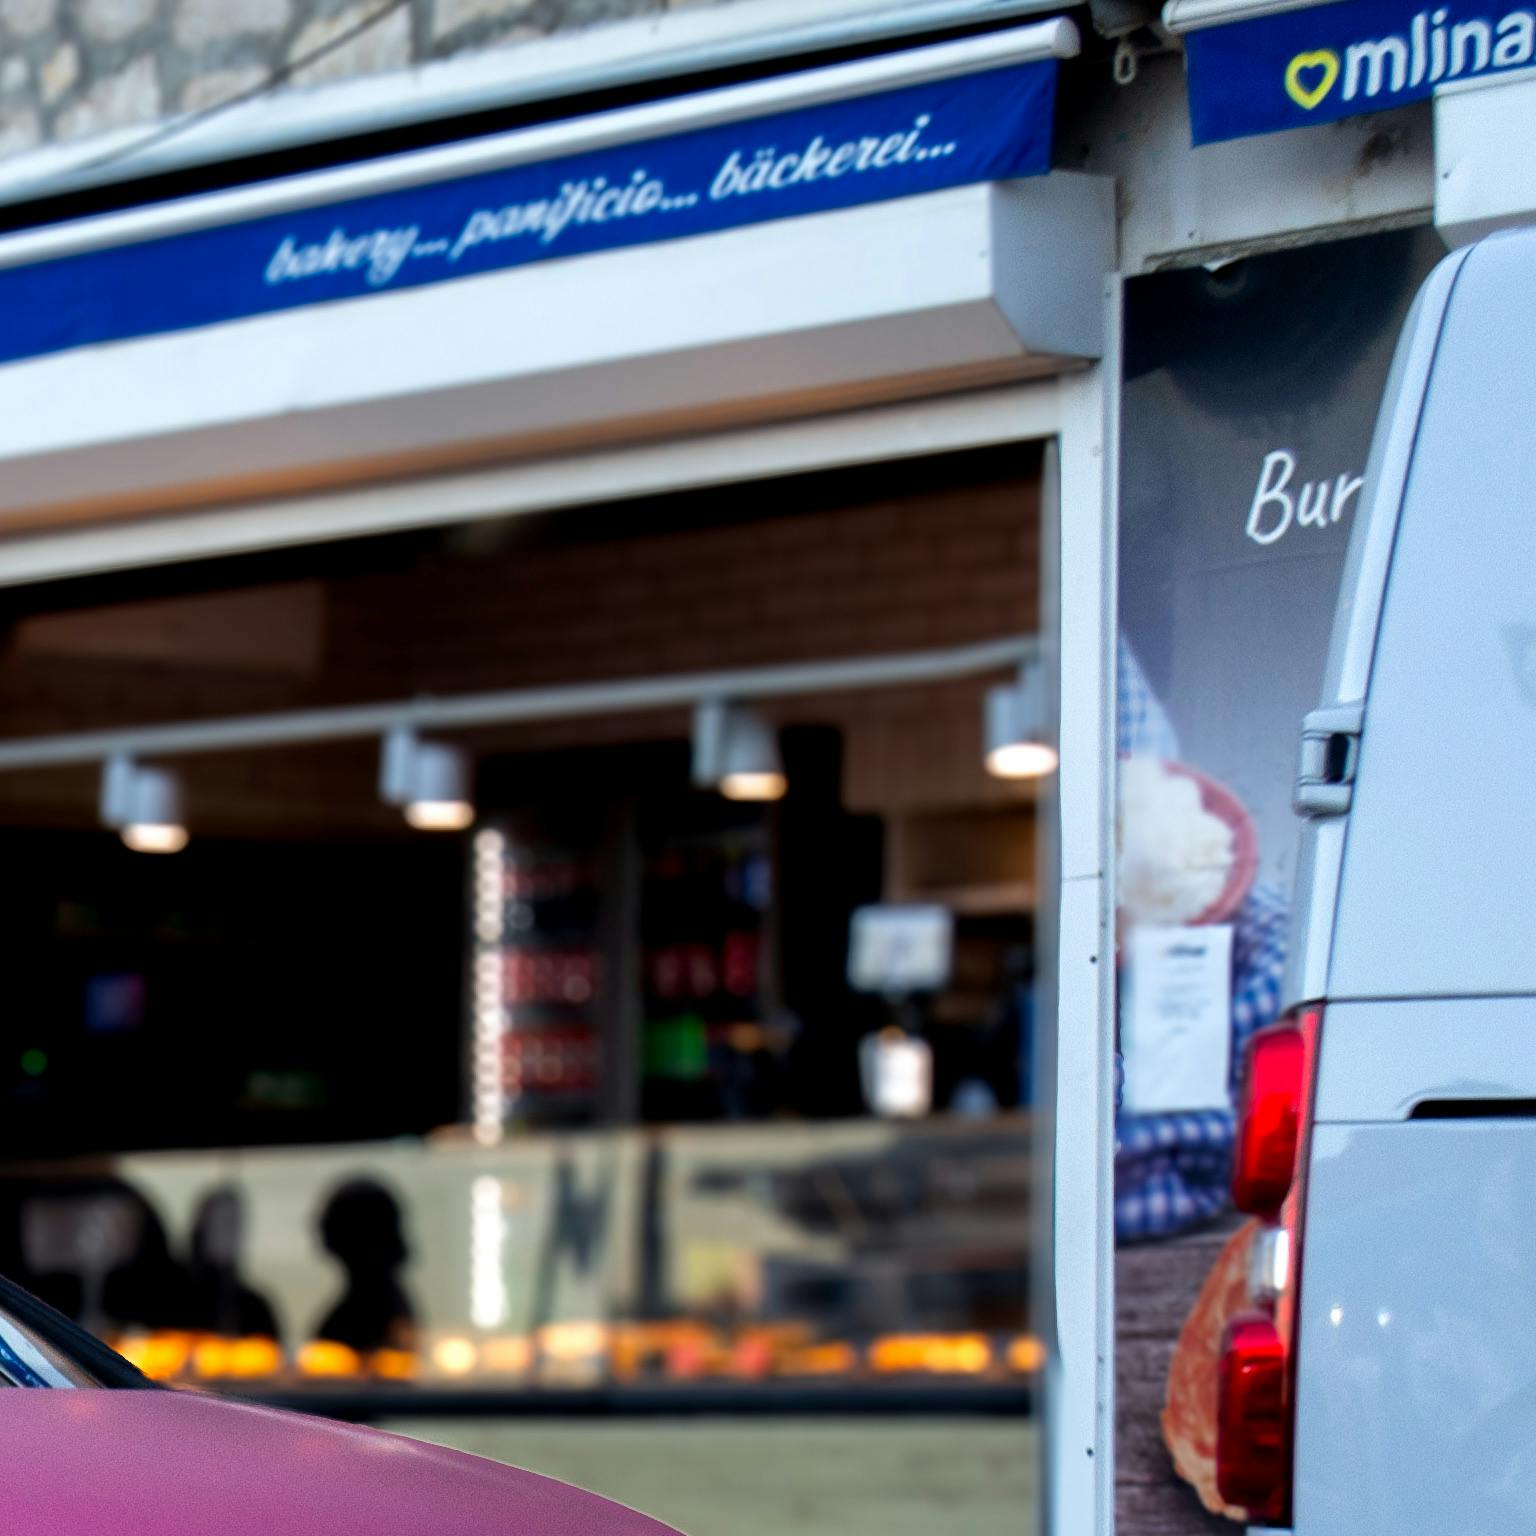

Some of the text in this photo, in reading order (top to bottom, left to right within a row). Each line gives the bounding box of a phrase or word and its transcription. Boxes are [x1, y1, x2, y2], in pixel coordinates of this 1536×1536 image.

[1342, 7, 1536, 101] mlina
[710, 113, 956, 200] bäckerei...
[1246, 450, 1365, 544] Bur
